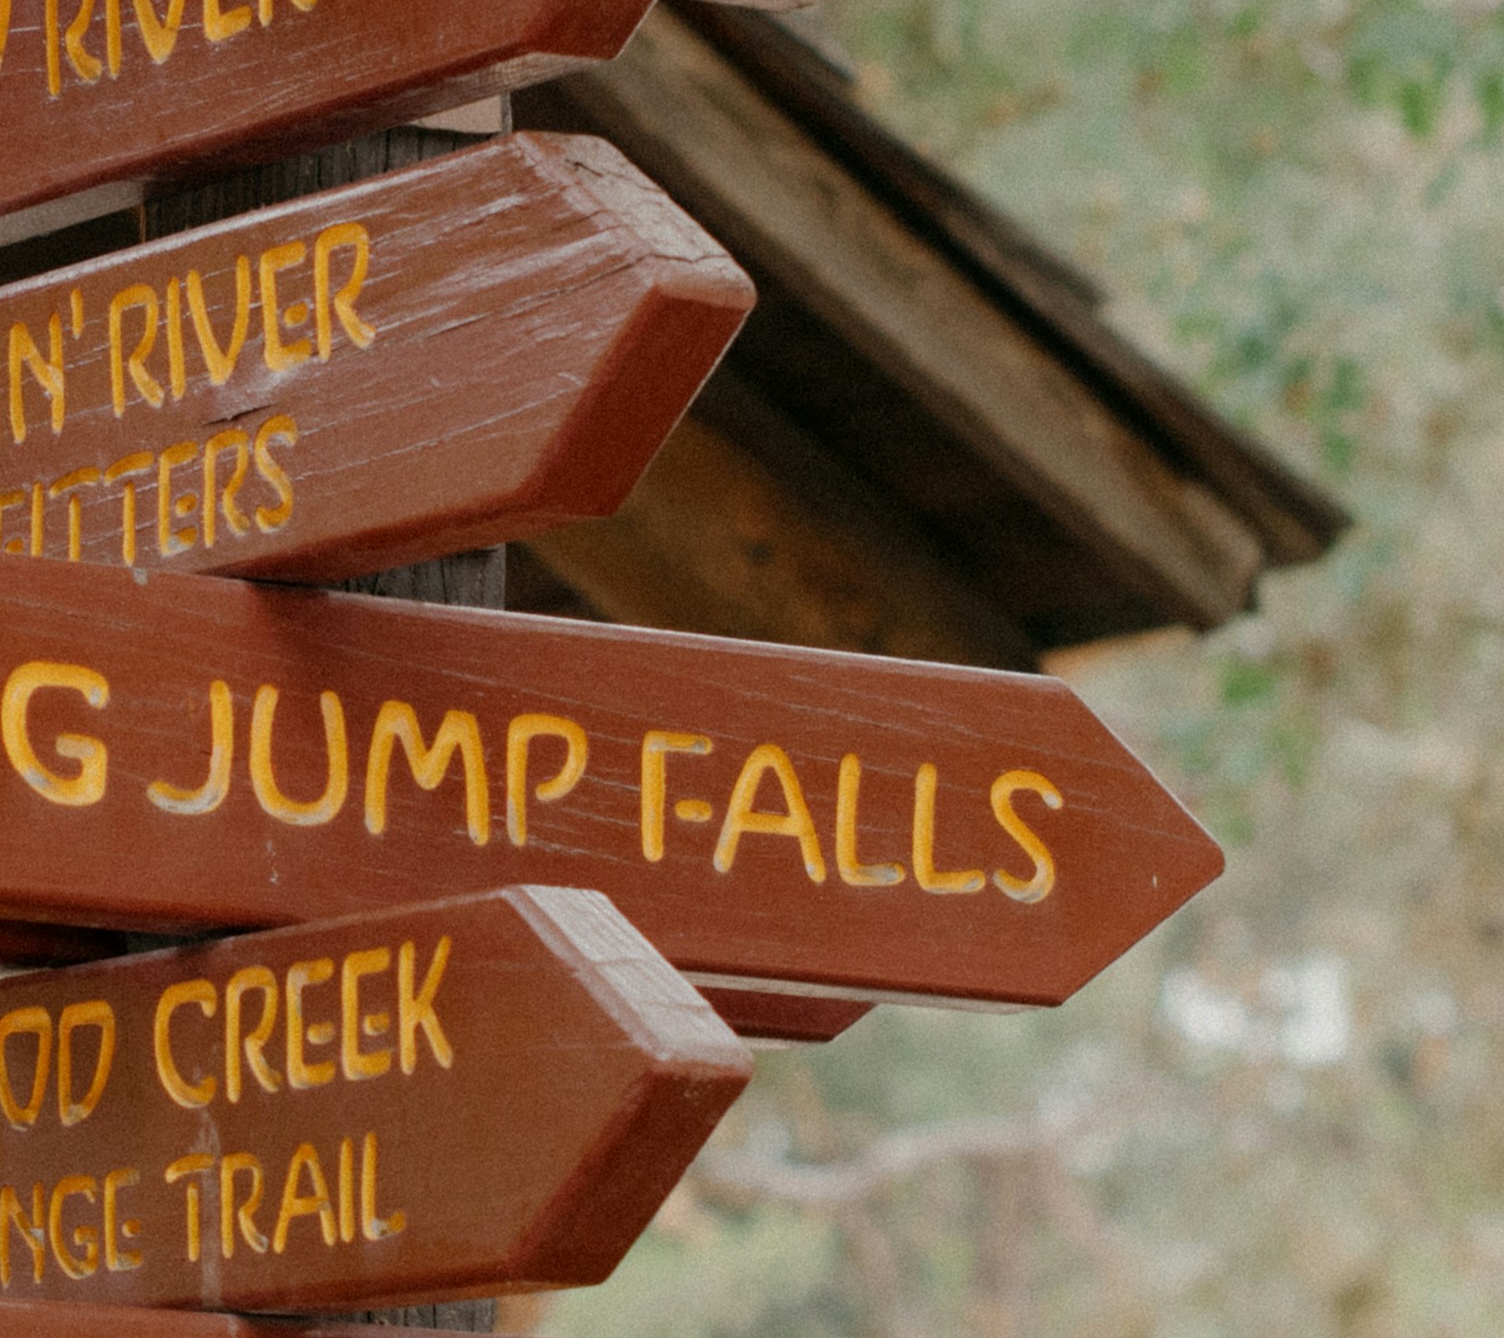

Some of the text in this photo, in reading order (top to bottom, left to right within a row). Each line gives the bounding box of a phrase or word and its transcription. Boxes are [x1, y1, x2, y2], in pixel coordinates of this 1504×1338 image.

[104, 218, 378, 416] RIVER
[146, 676, 591, 849] JUMP
[637, 726, 1065, 899] FALLS
[150, 933, 458, 1111] CREEK
[161, 1129, 408, 1265] TRAIL
